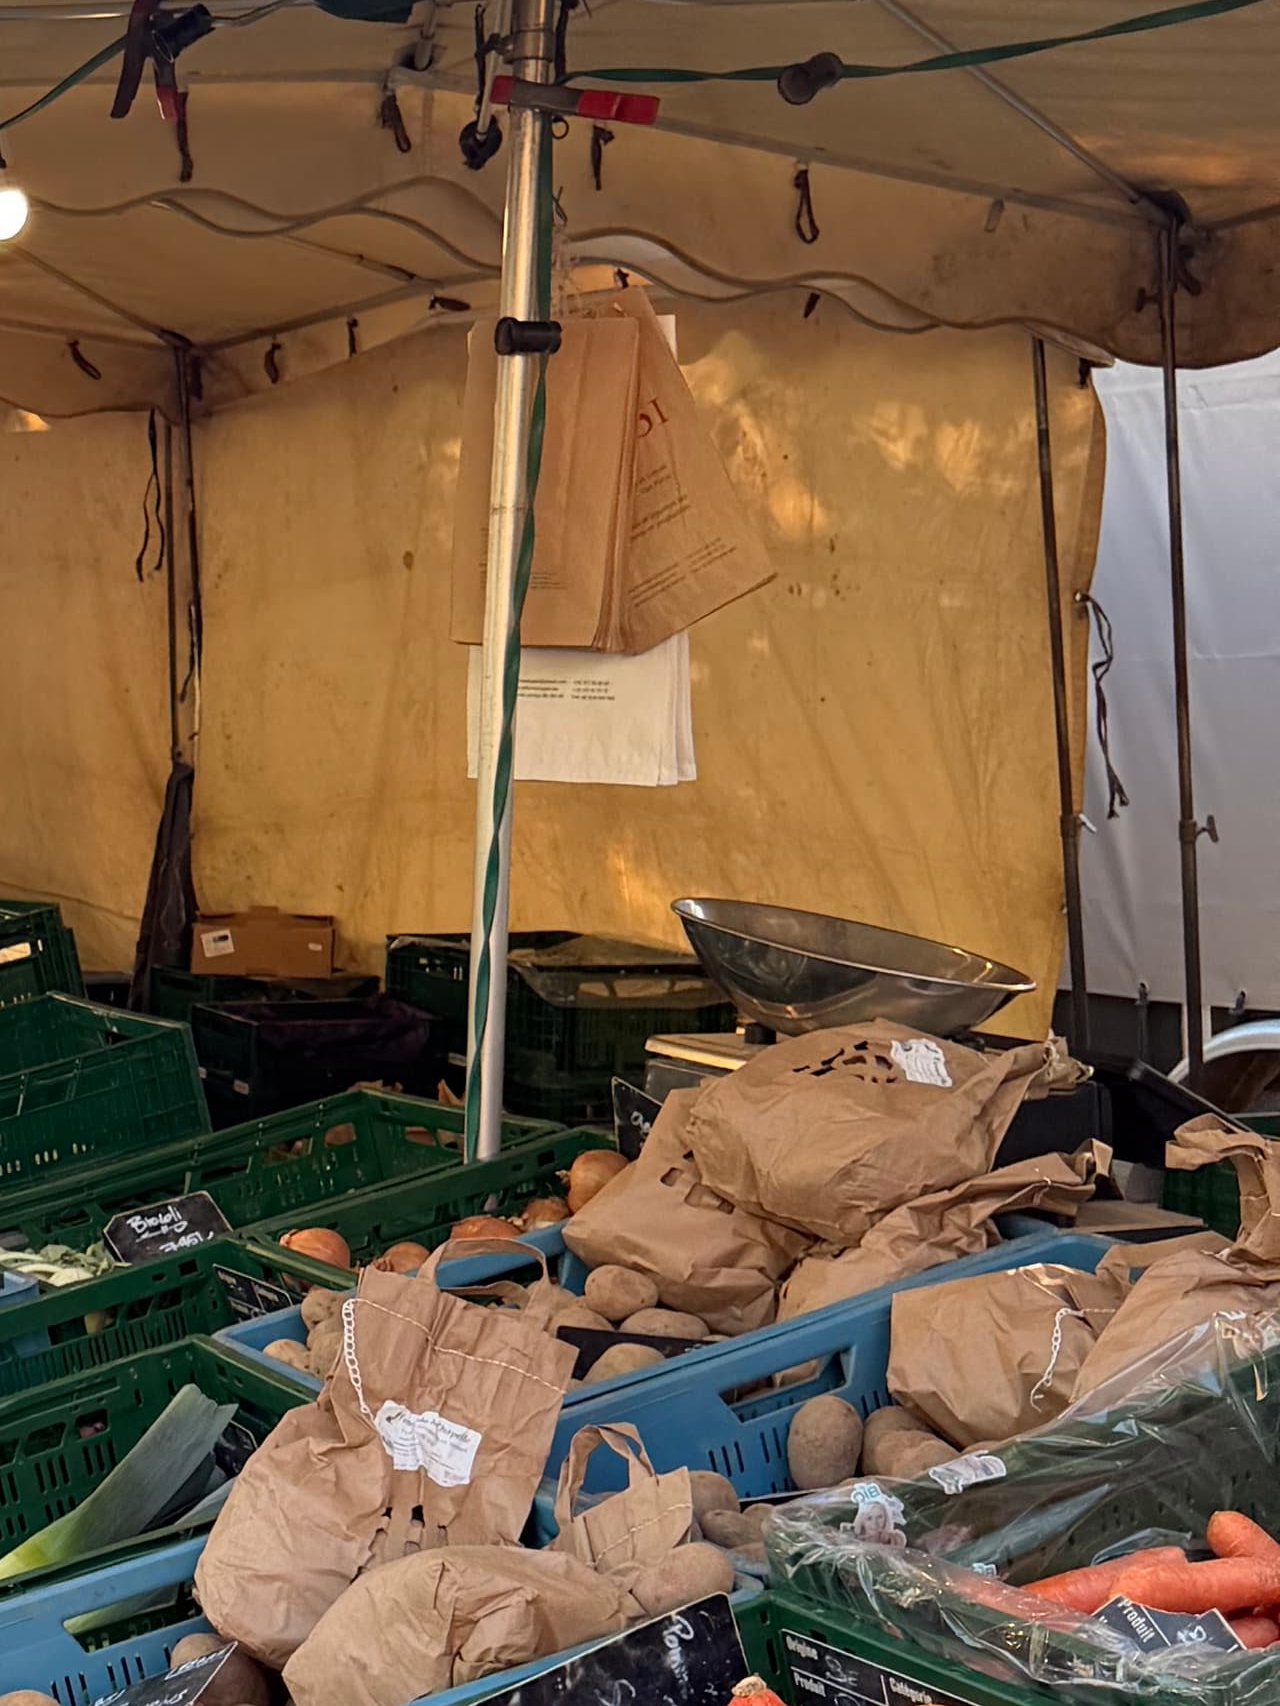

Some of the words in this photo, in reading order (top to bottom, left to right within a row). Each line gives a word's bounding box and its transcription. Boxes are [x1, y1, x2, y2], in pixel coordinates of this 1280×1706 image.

[1116, 1597, 1157, 1644] Produit
[785, 1635, 819, 1660] Origine
[793, 1672, 827, 1698] Produit
